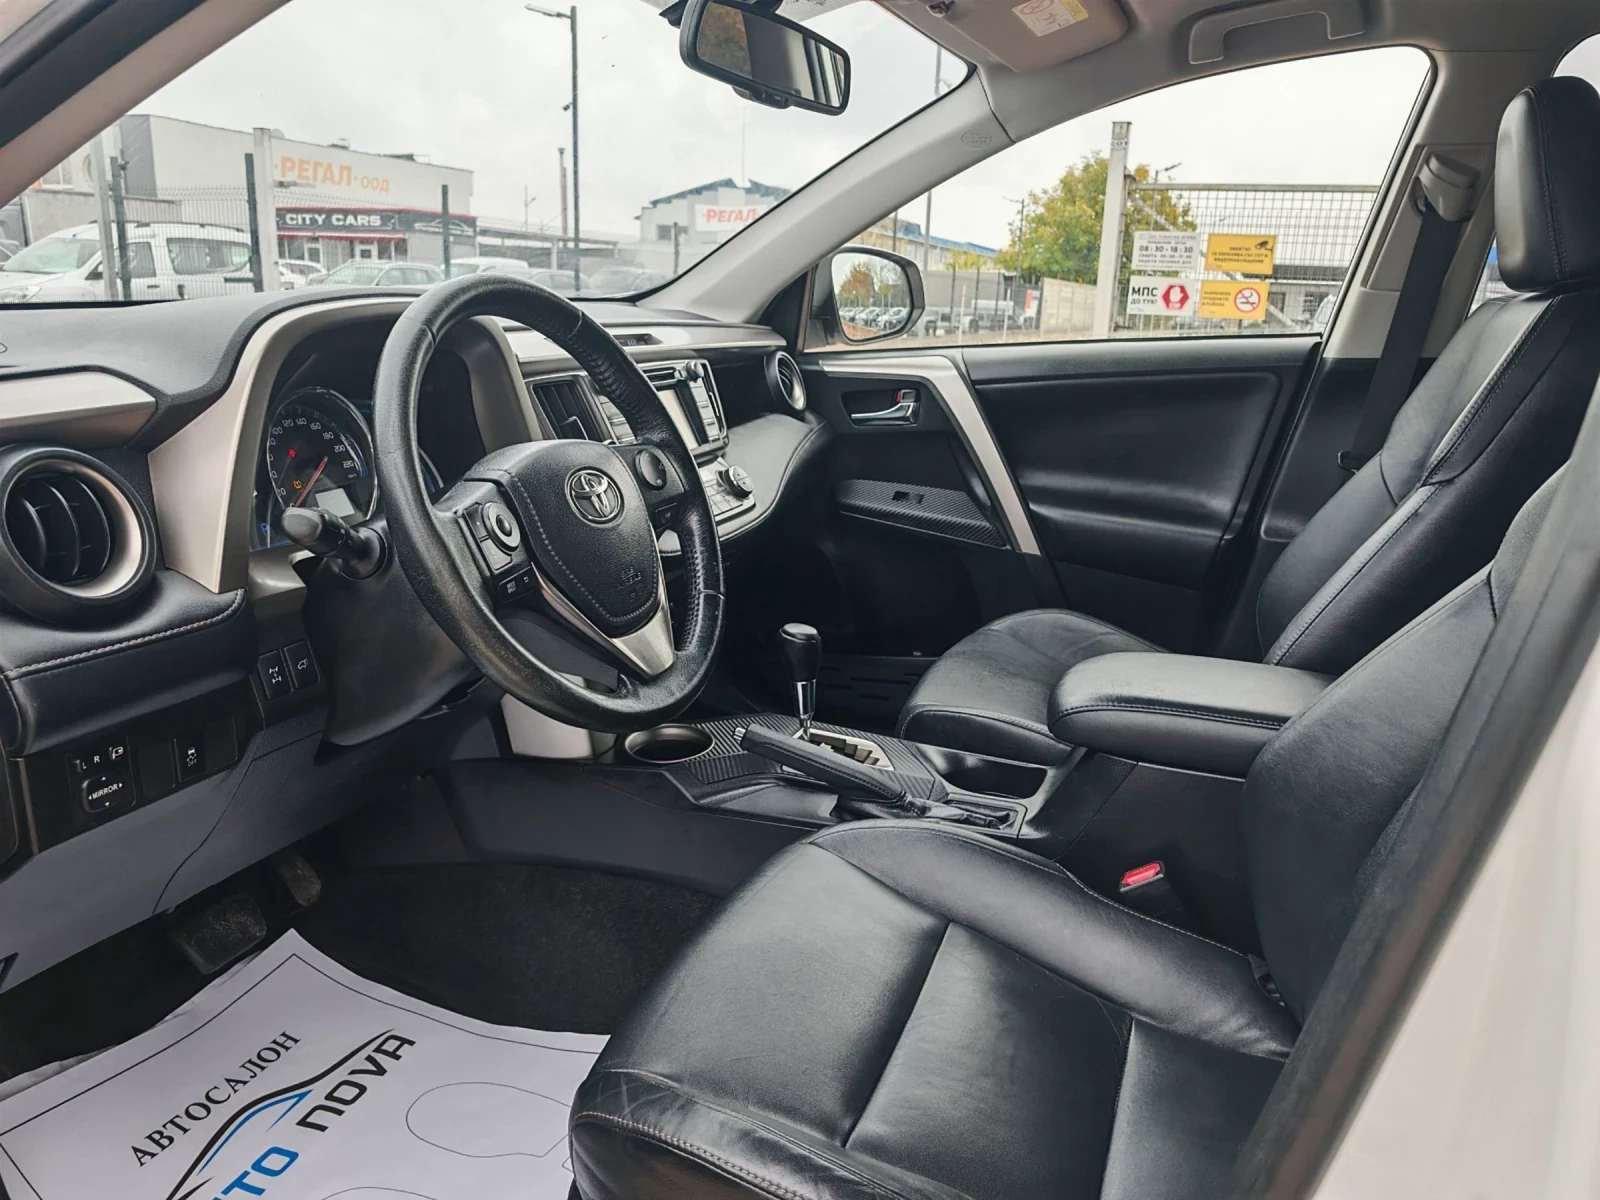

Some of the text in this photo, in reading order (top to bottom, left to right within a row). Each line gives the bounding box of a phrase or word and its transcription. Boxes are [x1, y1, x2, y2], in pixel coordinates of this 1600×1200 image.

[279, 155, 353, 187] РЕГАЛ
[285, 213, 381, 227] CITY CARS
[705, 208, 758, 223] РЕГАЛ
[1131, 286, 1158, 297] МПС
[93, 755, 100, 763] R
[92, 783, 118, 799] MIRROR
[130, 1031, 301, 1167] АВТОСАЛОН
[212, 1146, 299, 1200] TO
